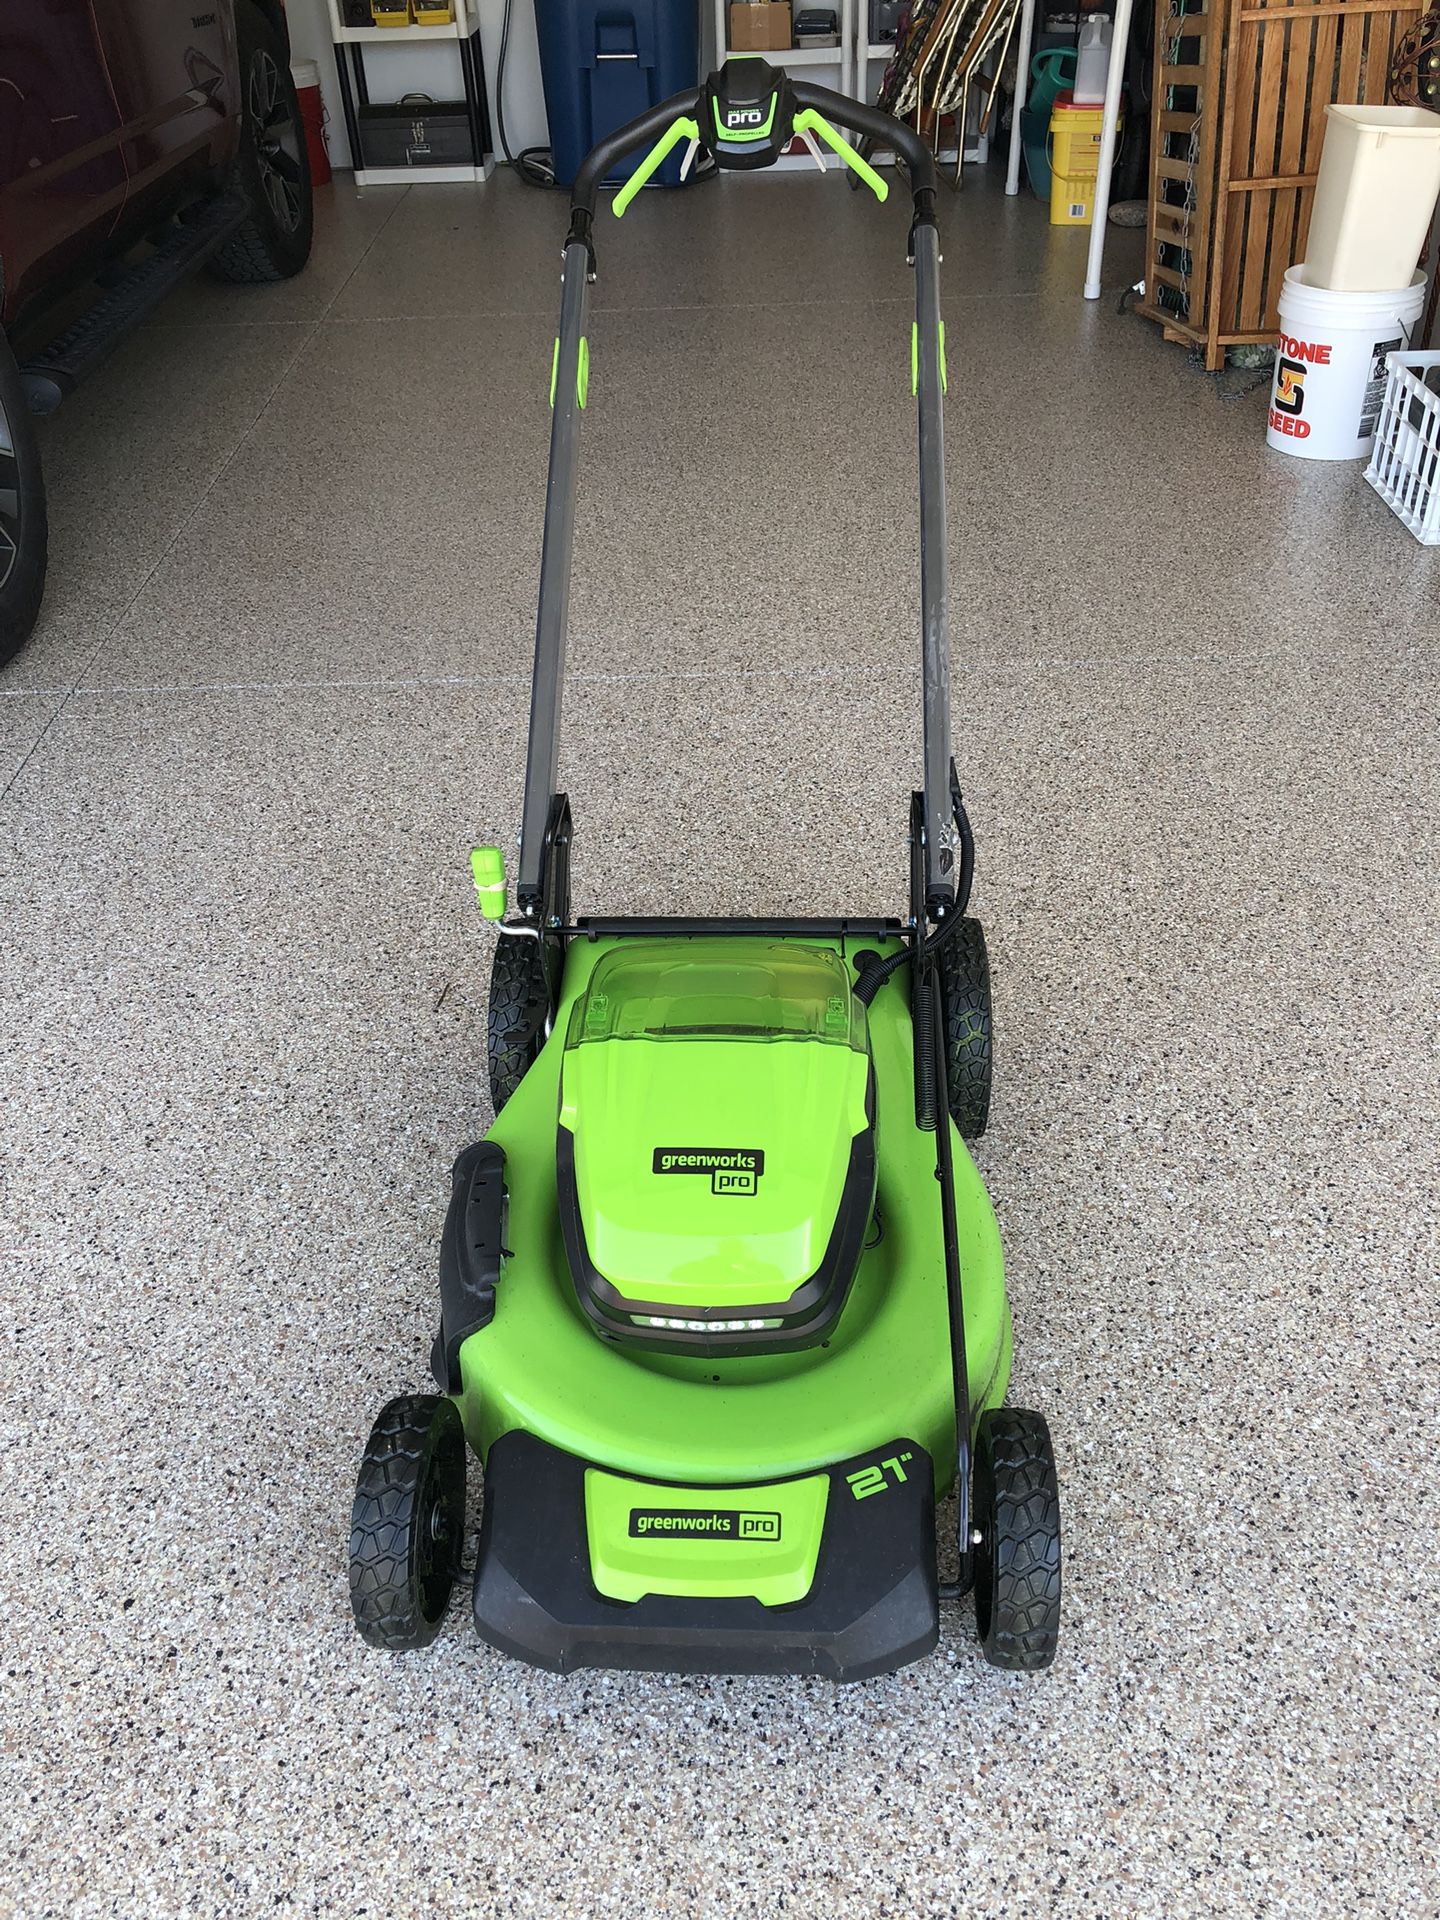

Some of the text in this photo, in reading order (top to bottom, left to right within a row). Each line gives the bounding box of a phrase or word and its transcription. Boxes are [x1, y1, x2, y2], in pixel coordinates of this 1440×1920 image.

[727, 112, 762, 127] pro
[1277, 332, 1333, 365] TONE
[1268, 407, 1312, 439] SEED
[661, 1152, 756, 1170] greenworks
[718, 1175, 751, 1190] pro
[637, 1514, 775, 1535] greenworks pro
